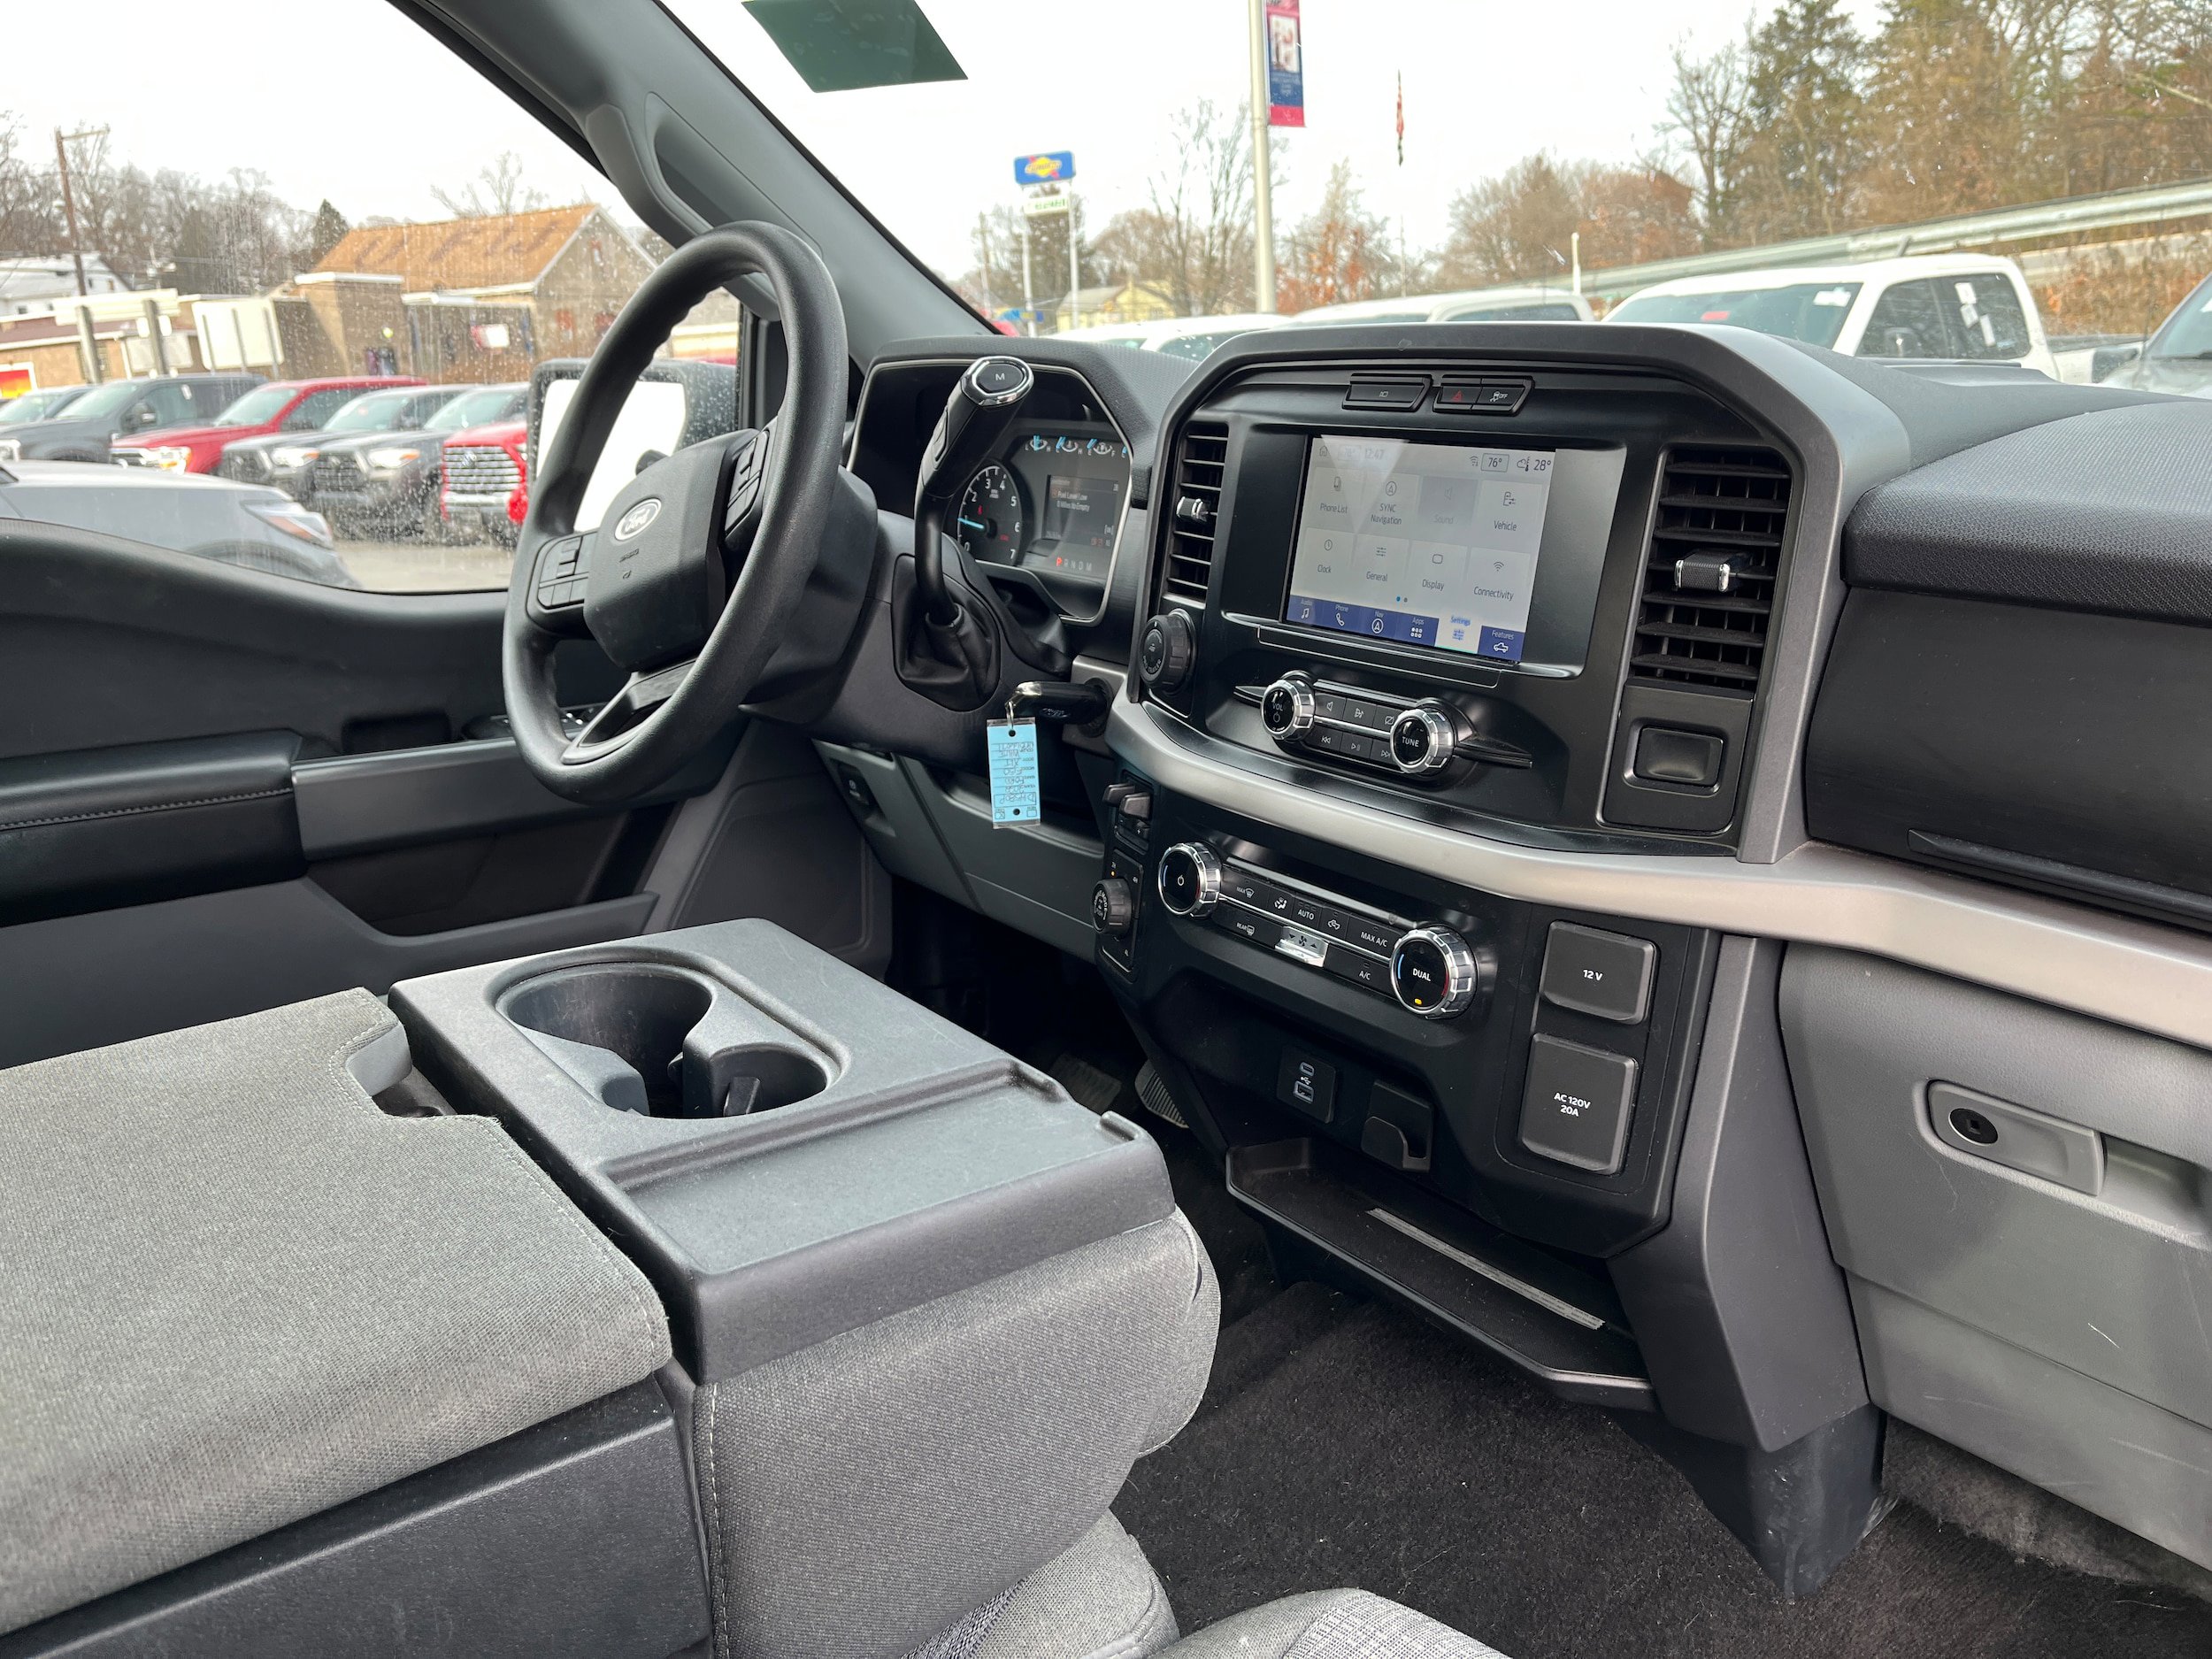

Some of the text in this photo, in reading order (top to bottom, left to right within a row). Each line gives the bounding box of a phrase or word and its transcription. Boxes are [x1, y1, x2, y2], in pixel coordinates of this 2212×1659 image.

[1487, 457, 1502, 468] 76°
[1532, 459, 1552, 472] 28°
[985, 479, 991, 489] 3
[999, 480, 1005, 490] 4
[972, 491, 978, 503] 2
[1010, 496, 1017, 507] 5
[1319, 503, 1348, 514] Phone List
[1379, 503, 1397, 513] SYNC
[1371, 514, 1402, 526] Navigation
[1494, 519, 1517, 532] Vehicle
[1014, 522, 1020, 533] 6
[964, 541, 970, 551] 0
[1010, 549, 1016, 559] 7
[1056, 557, 1063, 567] P
[1317, 564, 1332, 573] Clock
[1366, 571, 1388, 582] General
[1422, 579, 1445, 592] Display
[1473, 586, 1515, 602] Connectivity
[1335, 603, 1349, 612] Phone
[1412, 617, 1425, 626] Apps
[1450, 615, 1471, 626] Settings
[1491, 629, 1515, 641] Features
[1402, 736, 1420, 748] TUNE
[1297, 909, 1315, 920] AUTO
[1236, 922, 1248, 931] REAR
[1360, 931, 1388, 948] MAX A/C
[1359, 970, 1371, 980] A/C
[1412, 968, 1432, 982] DUAL
[1582, 970, 1603, 981] 12 V
[1554, 1092, 1591, 1110] AC 120V
[1560, 1104, 1579, 1118] 20A
